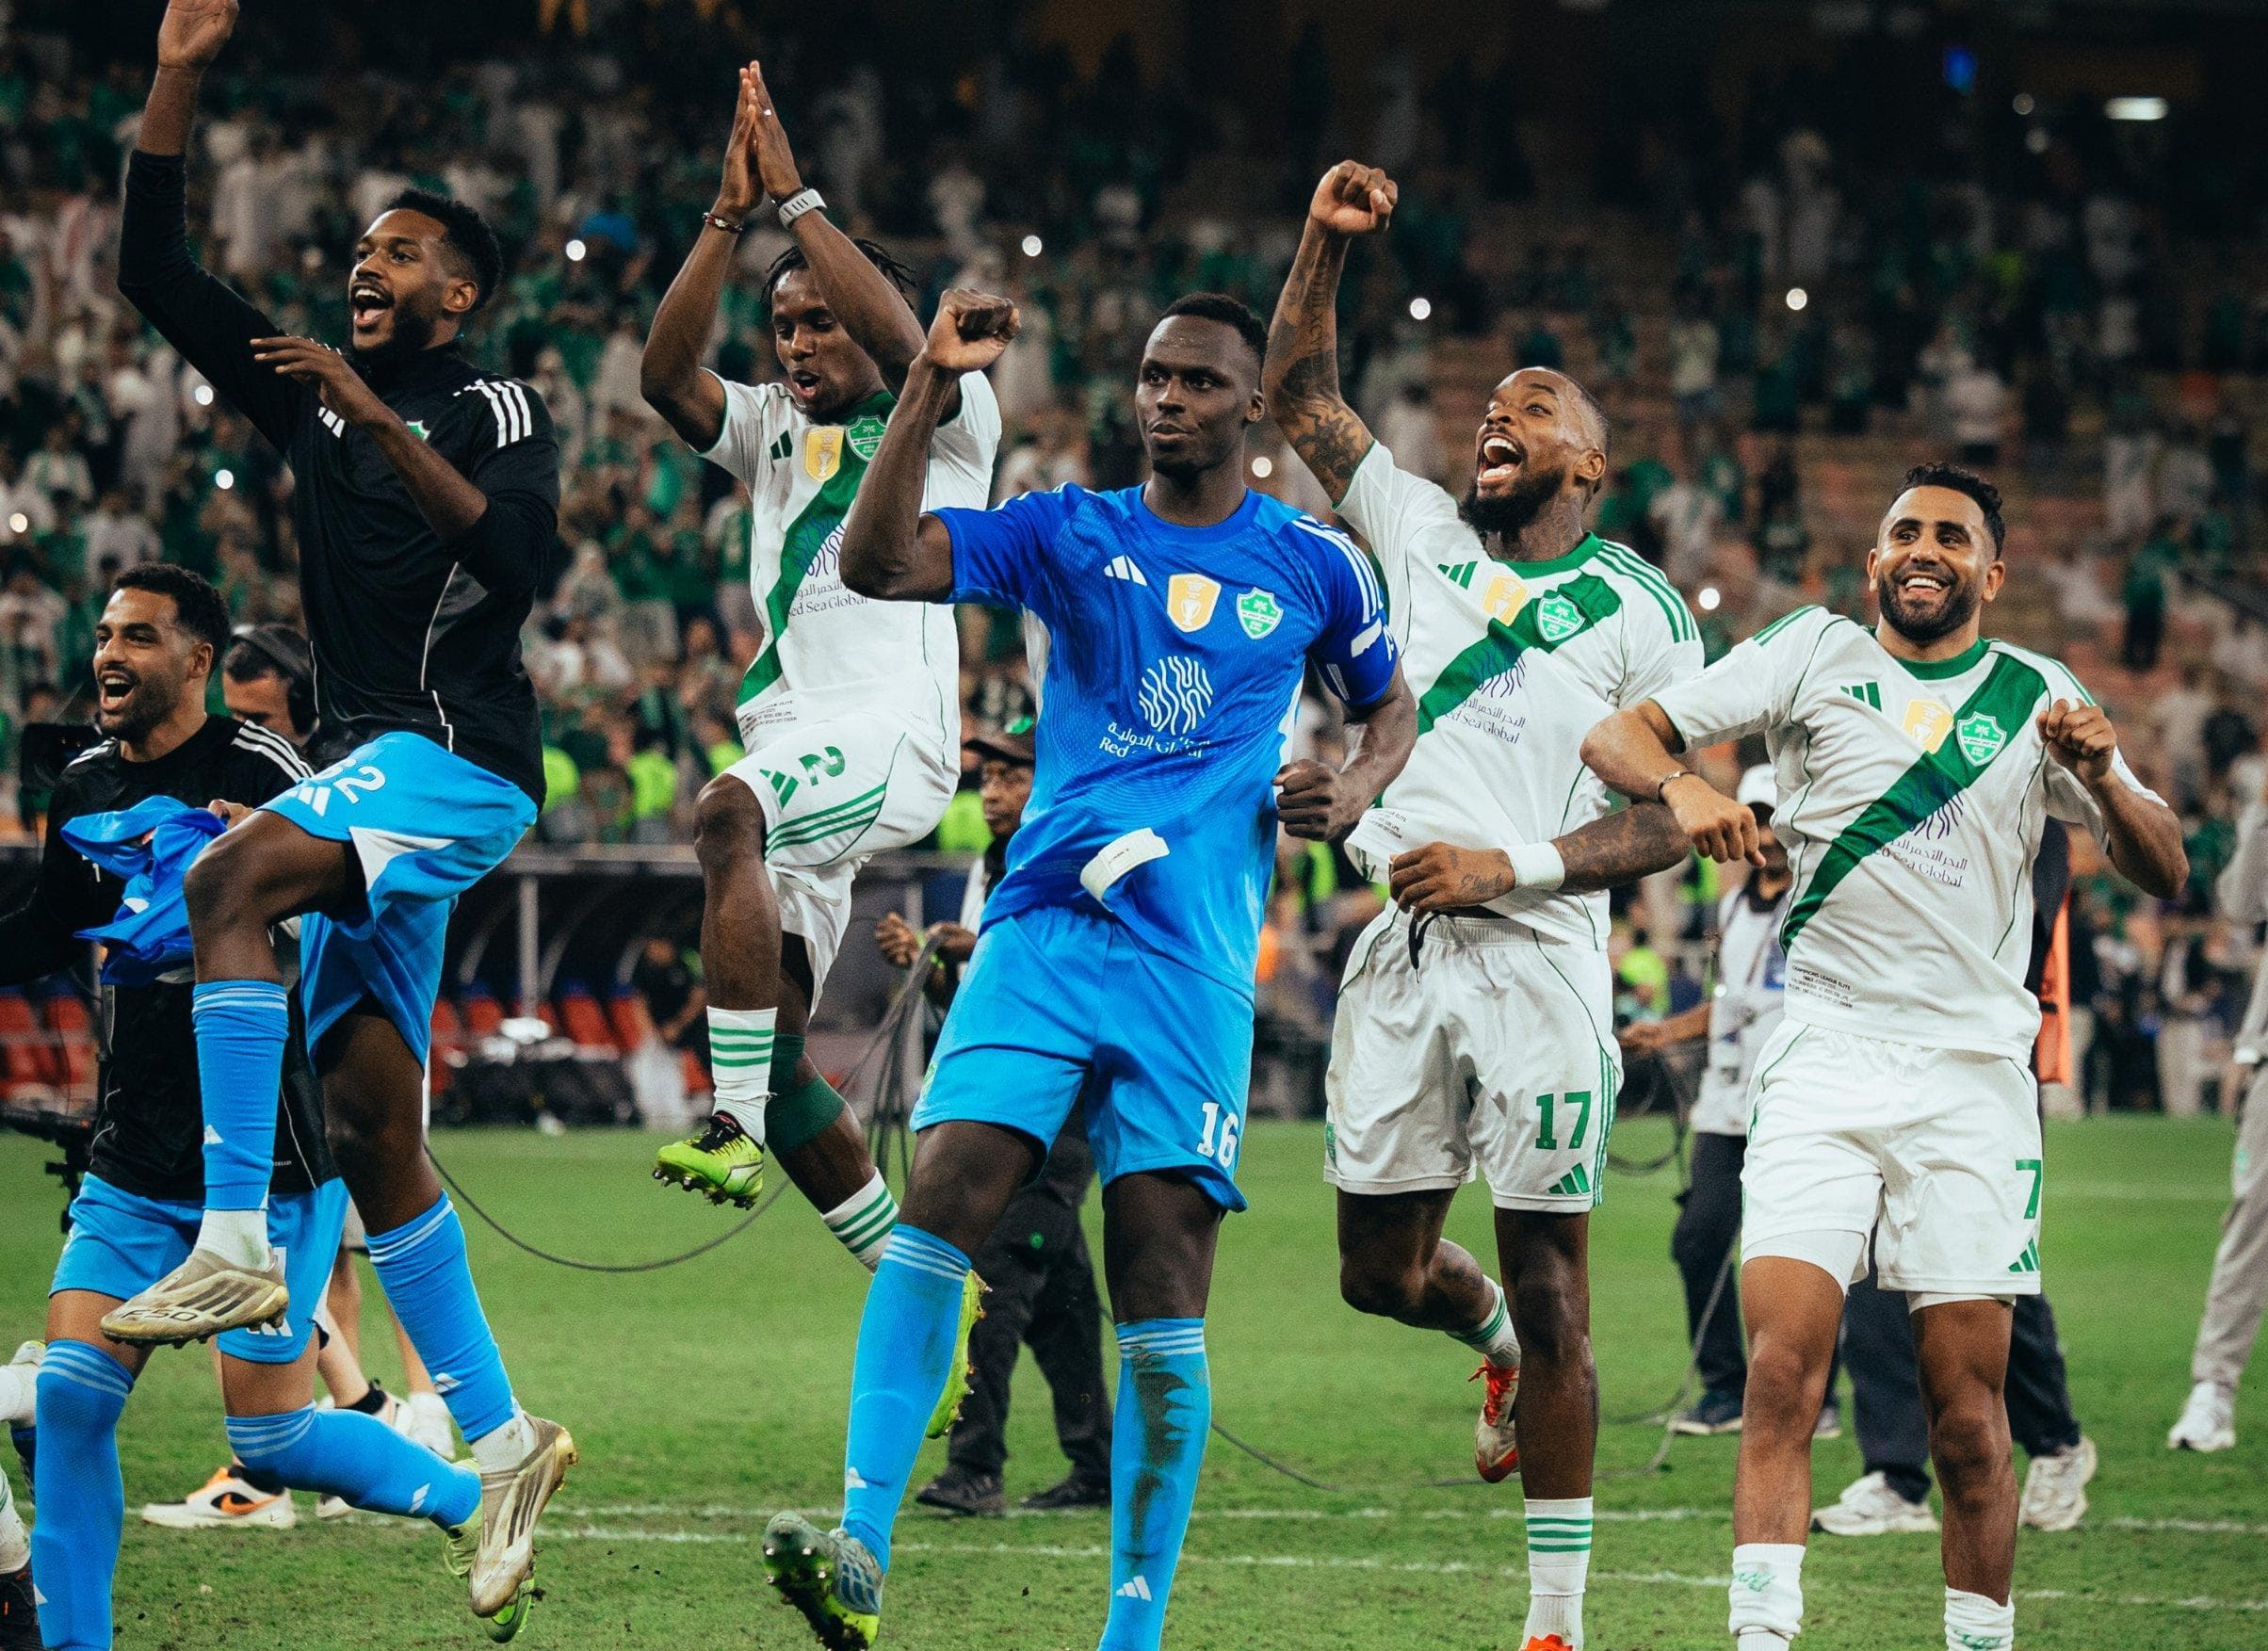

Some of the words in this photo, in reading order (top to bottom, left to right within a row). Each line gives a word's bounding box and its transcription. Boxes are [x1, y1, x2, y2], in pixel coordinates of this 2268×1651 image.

[789, 603, 803, 617] ed
[805, 601, 827, 614] Sea
[828, 593, 868, 609] Global
[1108, 721, 1155, 750] الدولية
[1445, 710, 1462, 720] ed
[1461, 713, 1482, 729] Sea
[1482, 721, 1520, 744] Global
[1099, 736, 1129, 758] Red
[1919, 863, 1963, 887] Global
[1196, 1101, 1239, 1168] 16
[1535, 1091, 1592, 1150] 17
[2015, 1158, 2042, 1220] 7
[121, 1309, 199, 1321] F50
